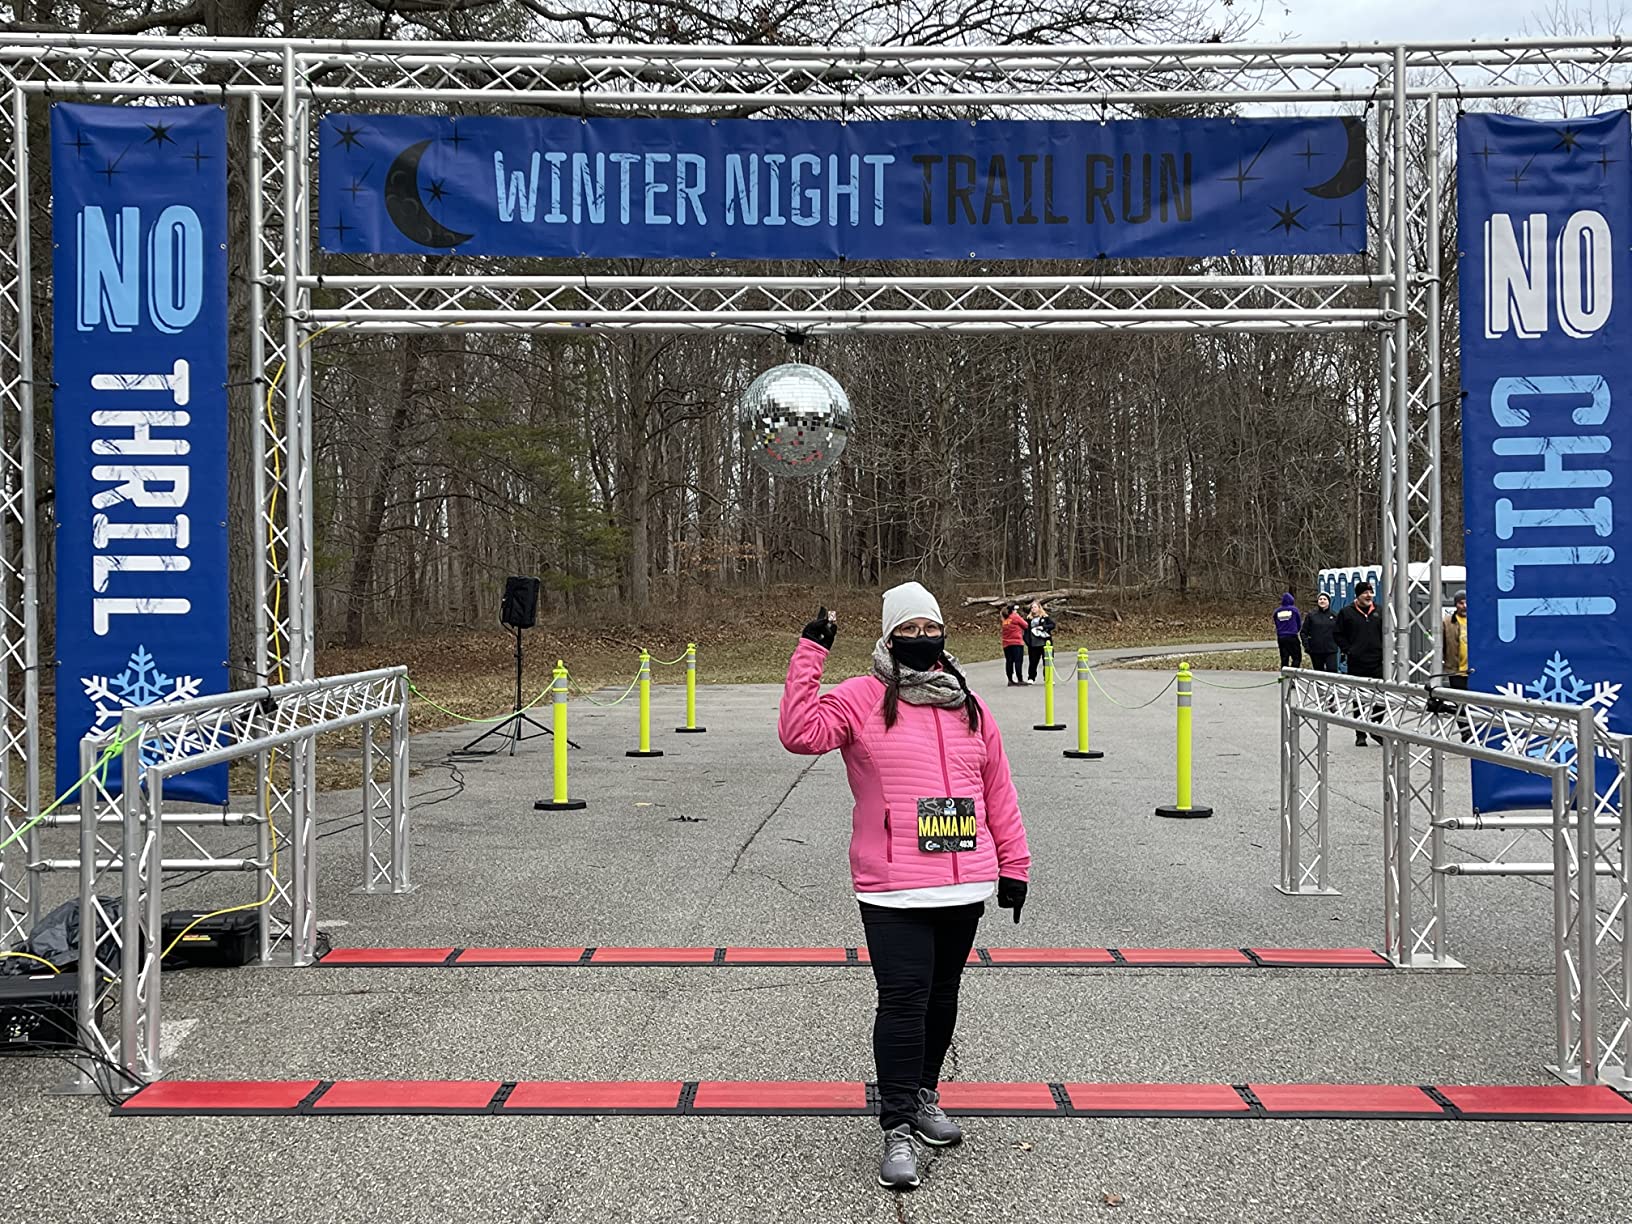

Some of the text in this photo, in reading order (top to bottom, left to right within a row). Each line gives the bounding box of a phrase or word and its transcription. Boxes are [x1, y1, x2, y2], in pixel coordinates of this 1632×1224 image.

[494, 150, 1193, 226] WINTER NIGHT TRAIL RUN
[77, 204, 203, 334] NO
[1484, 209, 1613, 339] NO
[91, 358, 191, 636] THRILL
[1490, 374, 1617, 643] CHILL
[918, 815, 976, 837] MAMA MO
